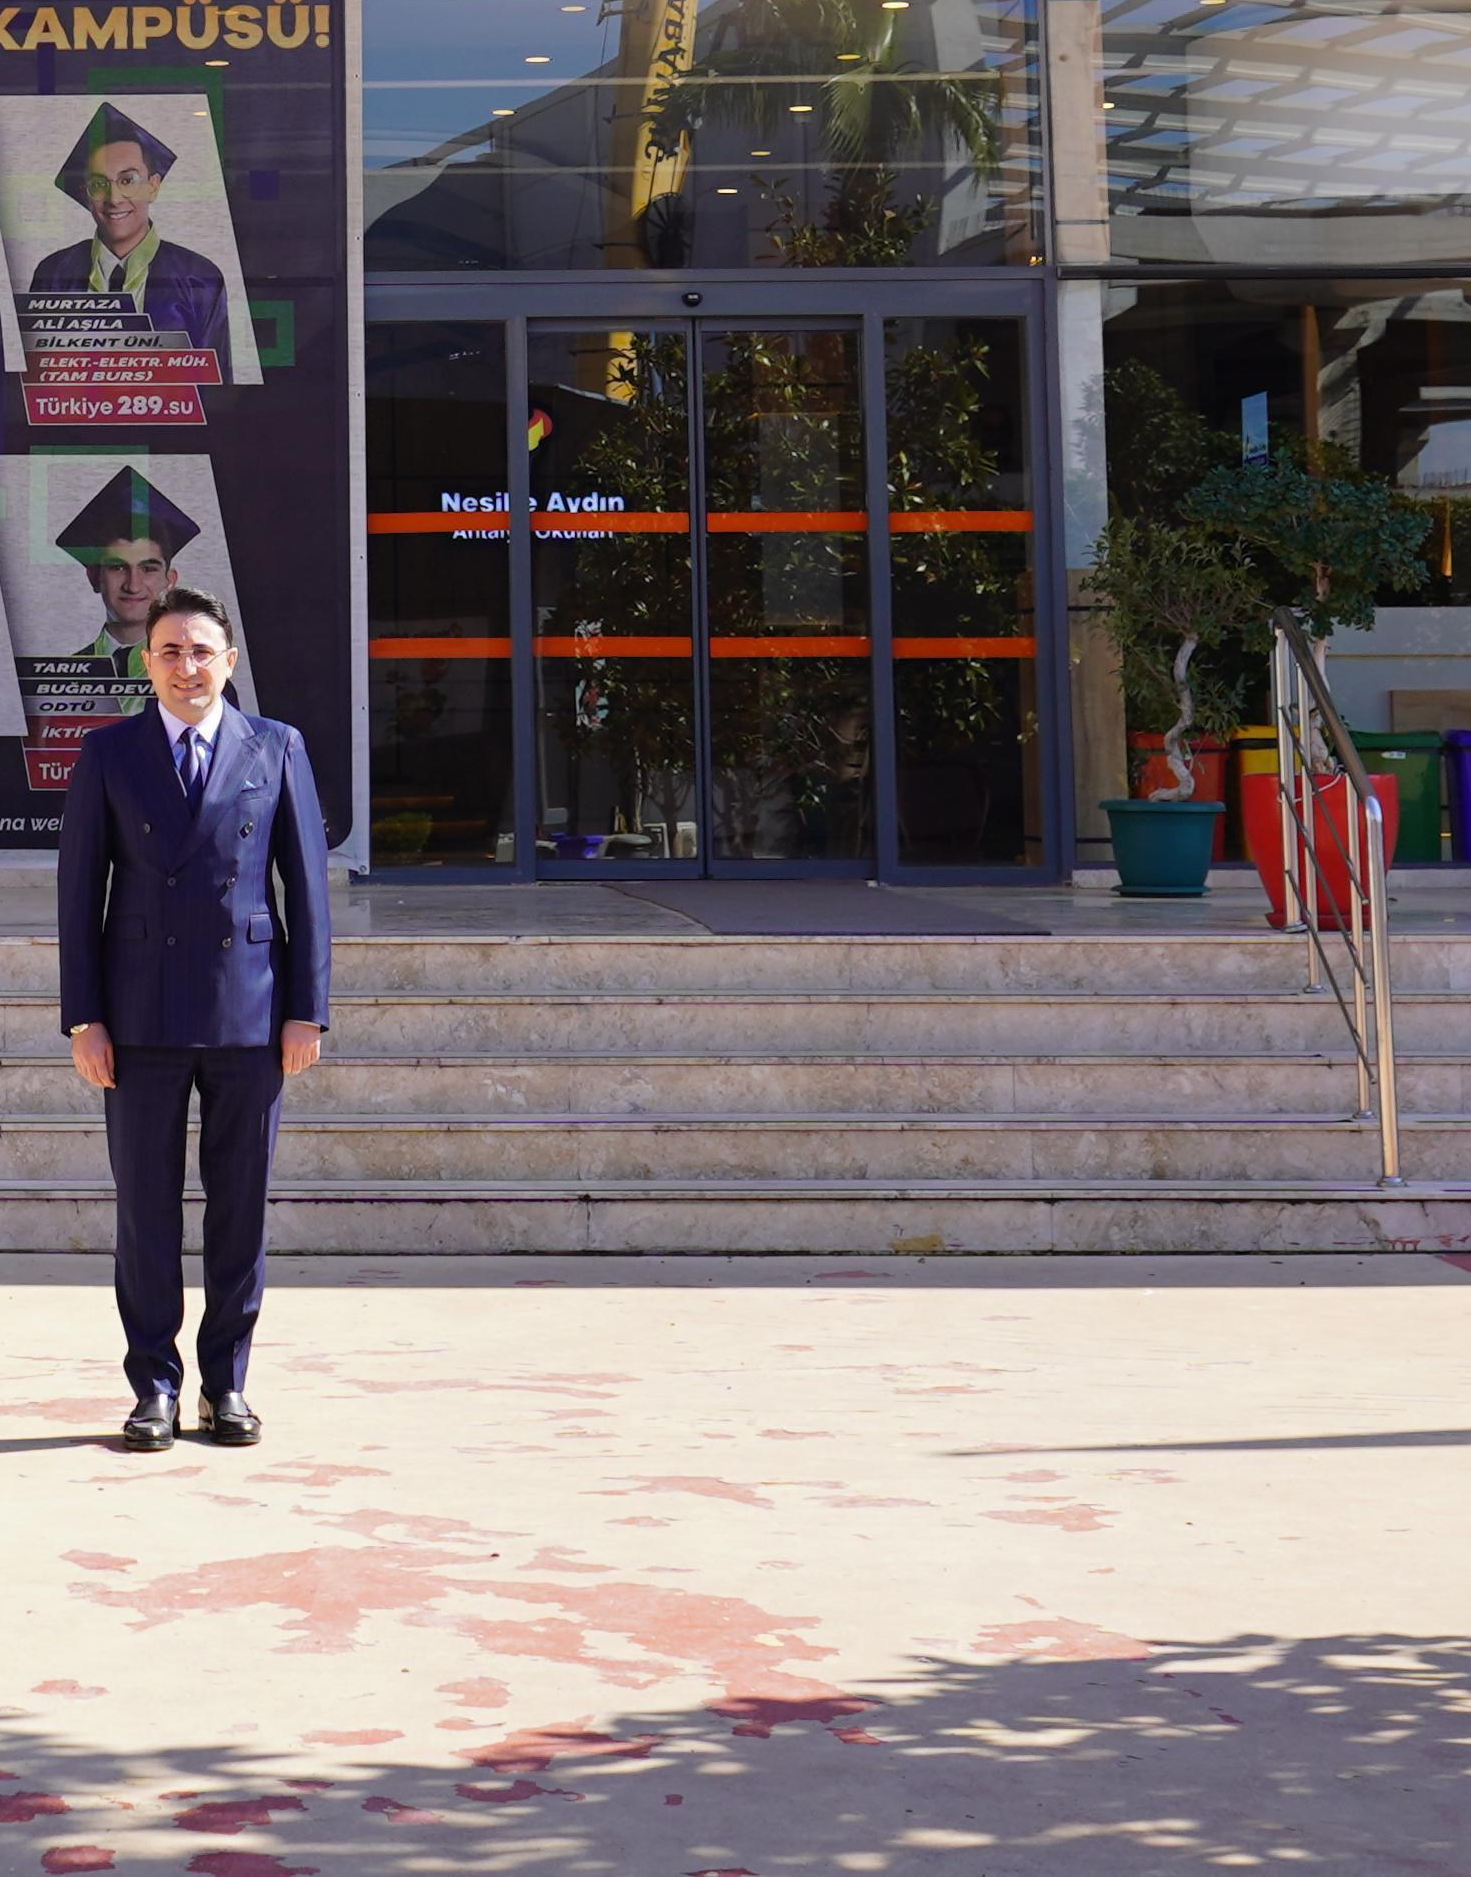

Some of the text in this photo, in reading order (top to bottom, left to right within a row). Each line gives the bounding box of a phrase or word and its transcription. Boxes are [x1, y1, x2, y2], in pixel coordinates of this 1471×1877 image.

[27, 299, 122, 310] MURTAZA
[30, 317, 124, 331] ALİ AŞILA
[34, 335, 164, 348] BİLKENT ÜNİ.
[38, 354, 209, 368] ELEKT.-ELEKTR. MÜH.
[39, 370, 154, 383] (TAM BURS)
[35, 395, 194, 419] Türkiye 289.su
[32, 662, 92, 674] TARIK
[36, 682, 155, 695] BUĞRA DEV
[39, 699, 96, 712] ODTÜ
